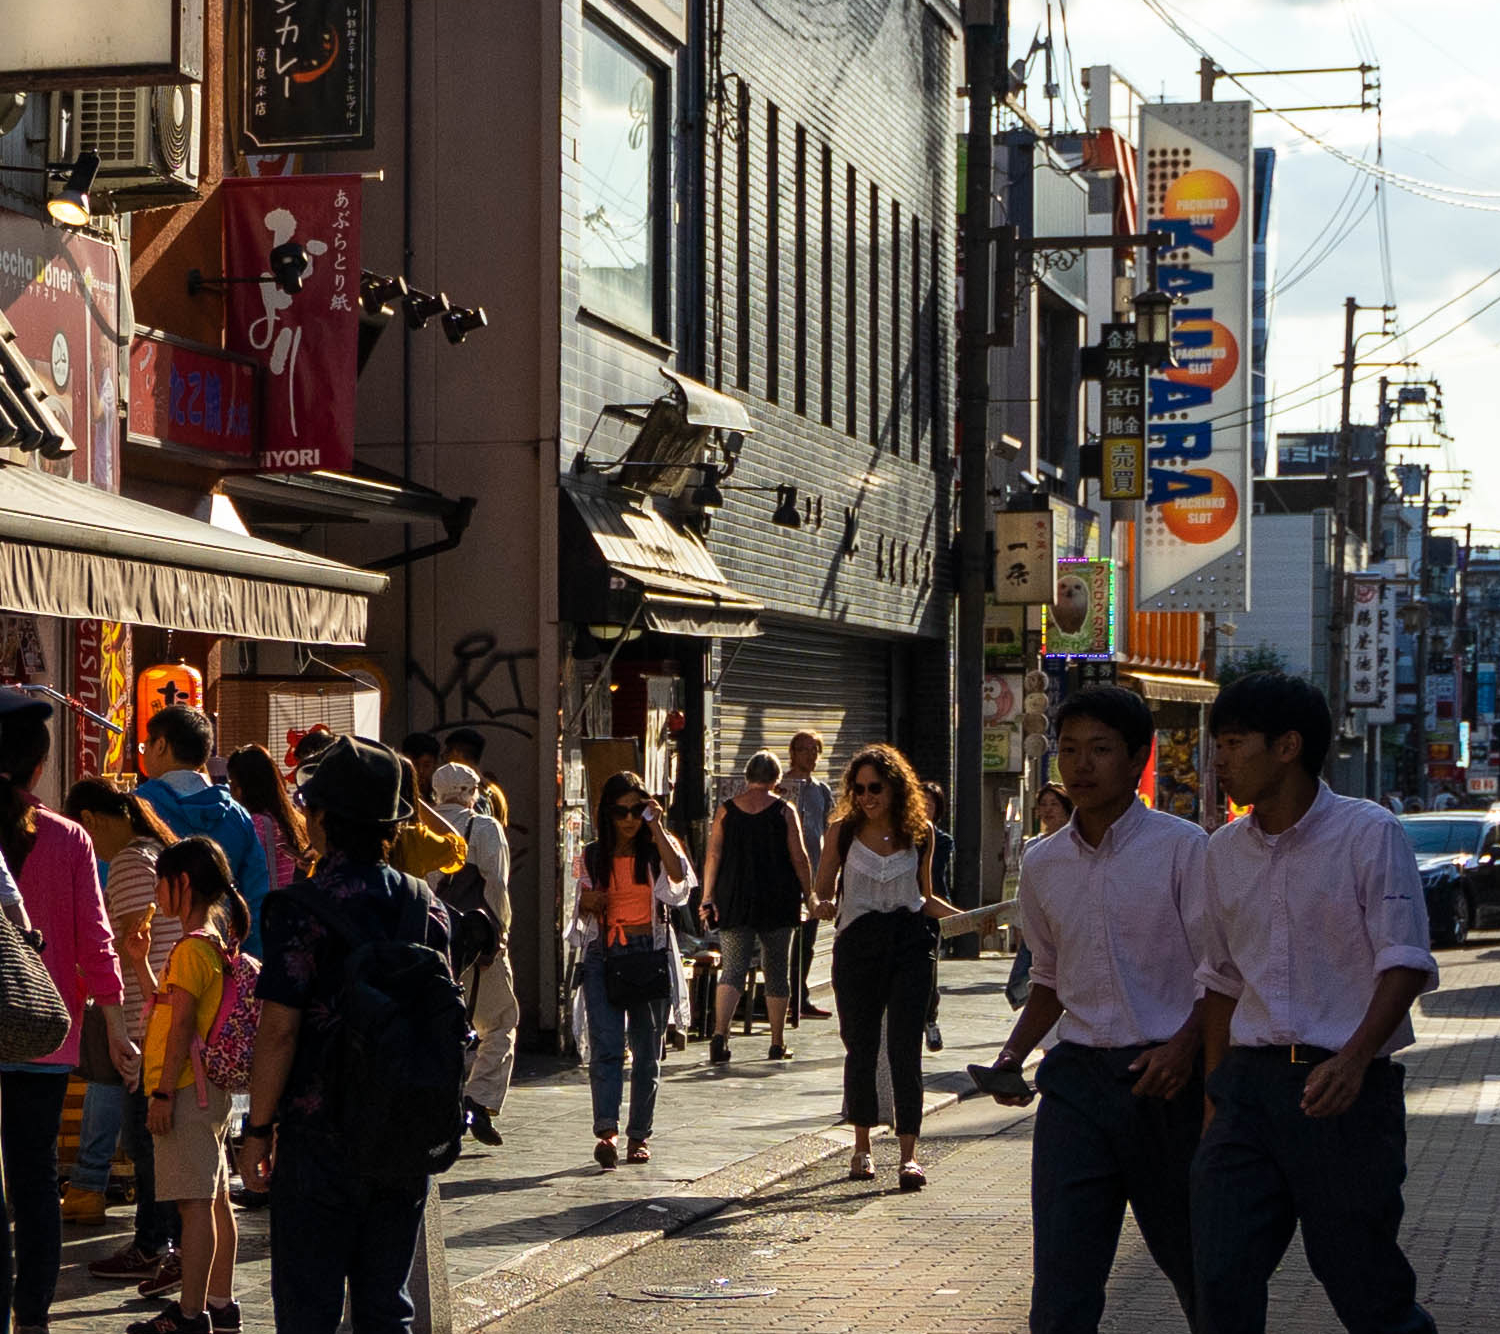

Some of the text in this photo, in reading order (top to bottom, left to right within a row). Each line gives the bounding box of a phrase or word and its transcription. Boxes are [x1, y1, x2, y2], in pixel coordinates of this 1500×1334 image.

[331, 188, 353, 312] あぶらとり紙
[1188, 362, 1214, 375] SLOT
[1106, 387, 1140, 407] 宝石
[1106, 416, 1141, 435] 地金
[1112, 445, 1136, 493] 売買
[1188, 512, 1213, 525] SLOT
